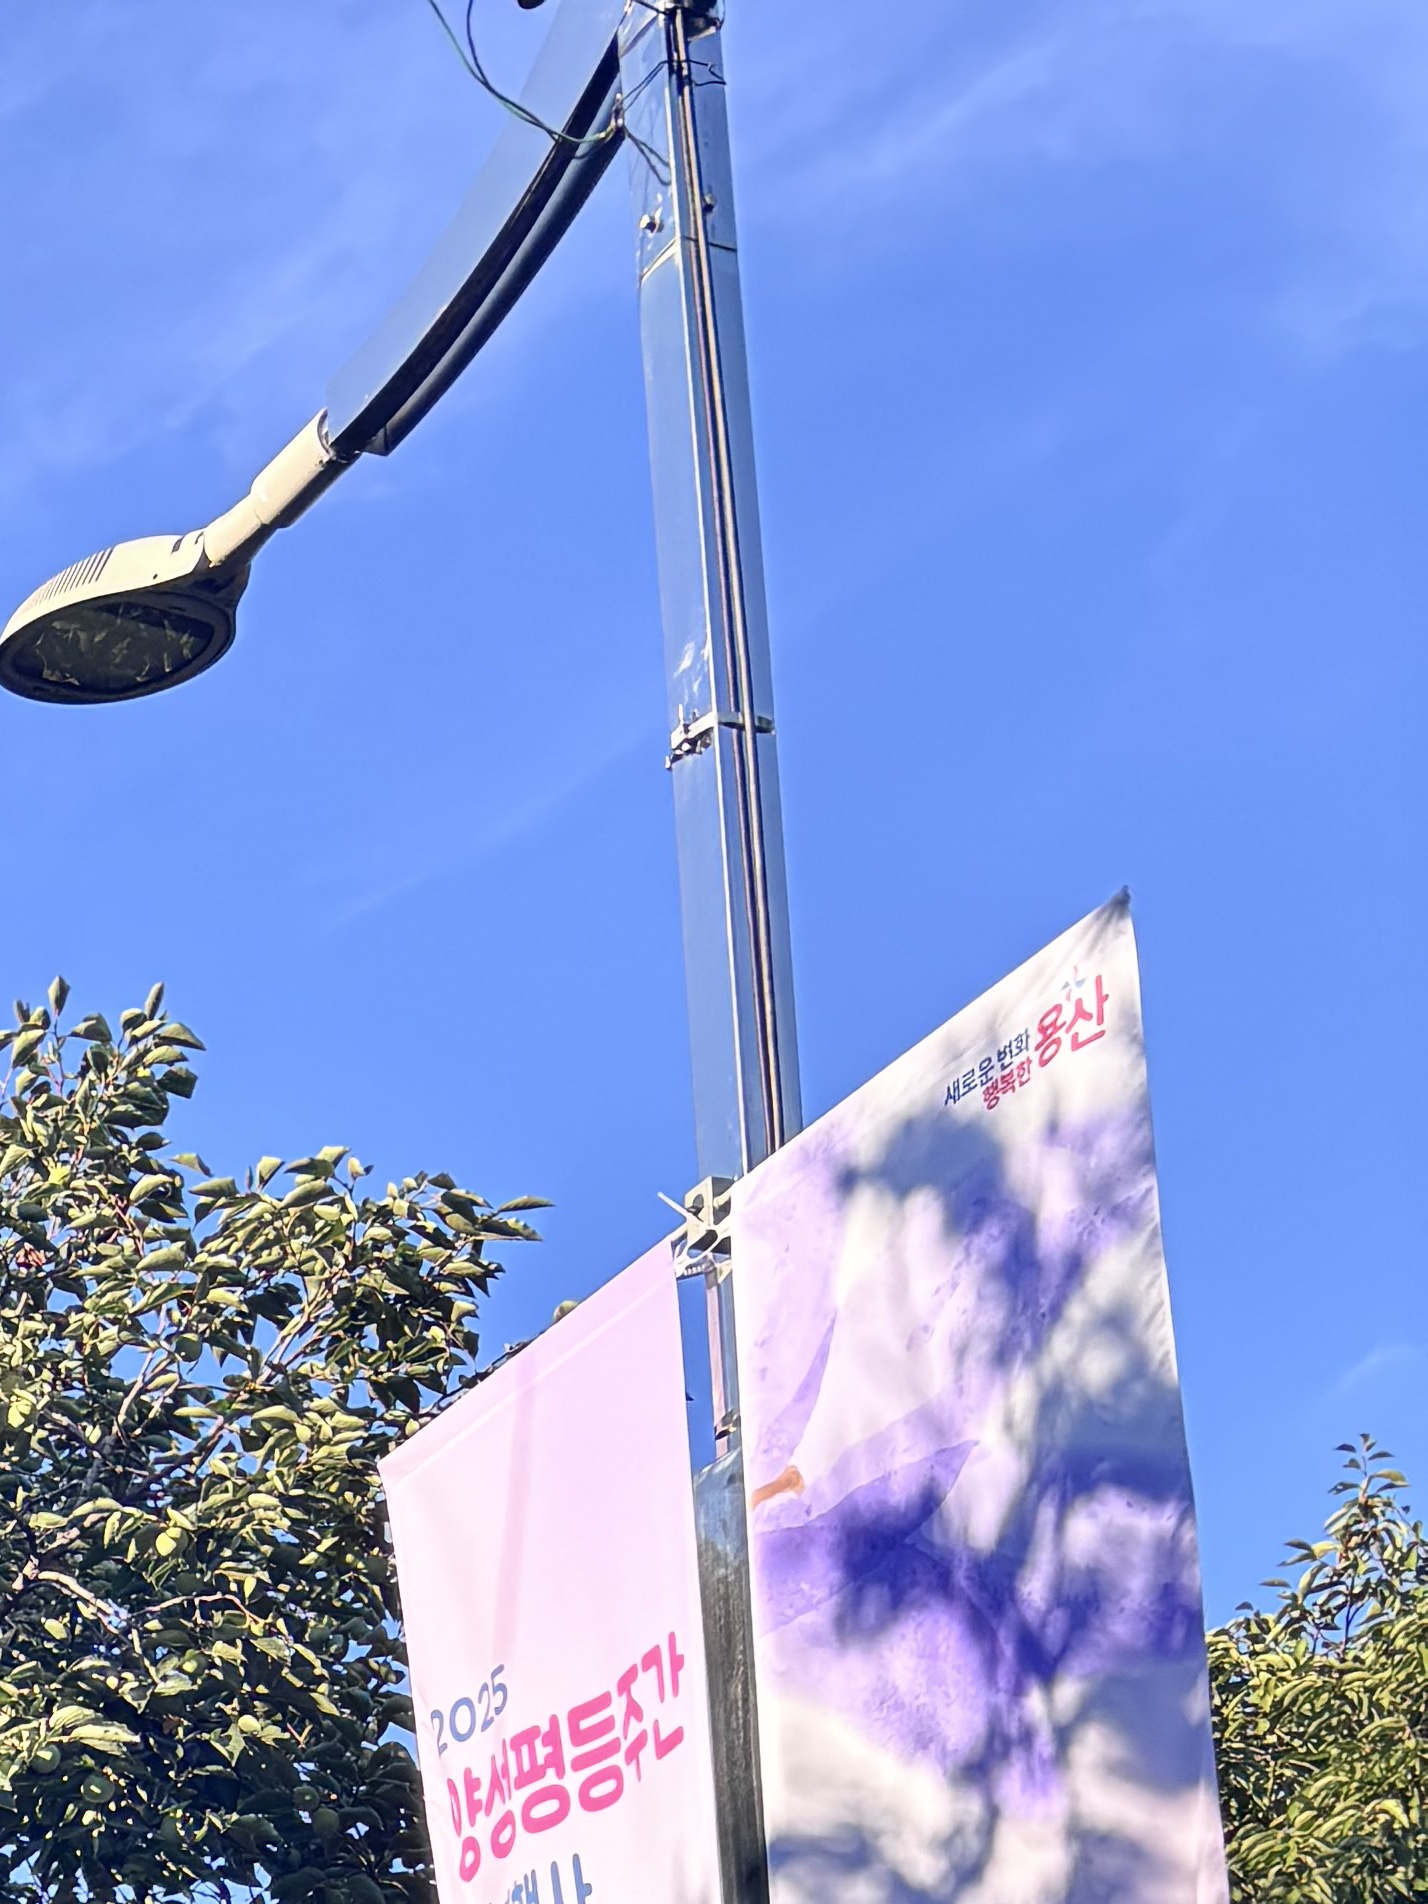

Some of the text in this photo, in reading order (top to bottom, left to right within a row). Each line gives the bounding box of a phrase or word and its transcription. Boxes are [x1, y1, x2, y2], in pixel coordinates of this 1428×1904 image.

[1033, 974, 1110, 1068] 용산
[944, 1056, 994, 1106] 새로운
[982, 1056, 1033, 1111] 행복한
[430, 1664, 508, 1758] 2025
[446, 1630, 686, 1883] 양성평등주간
